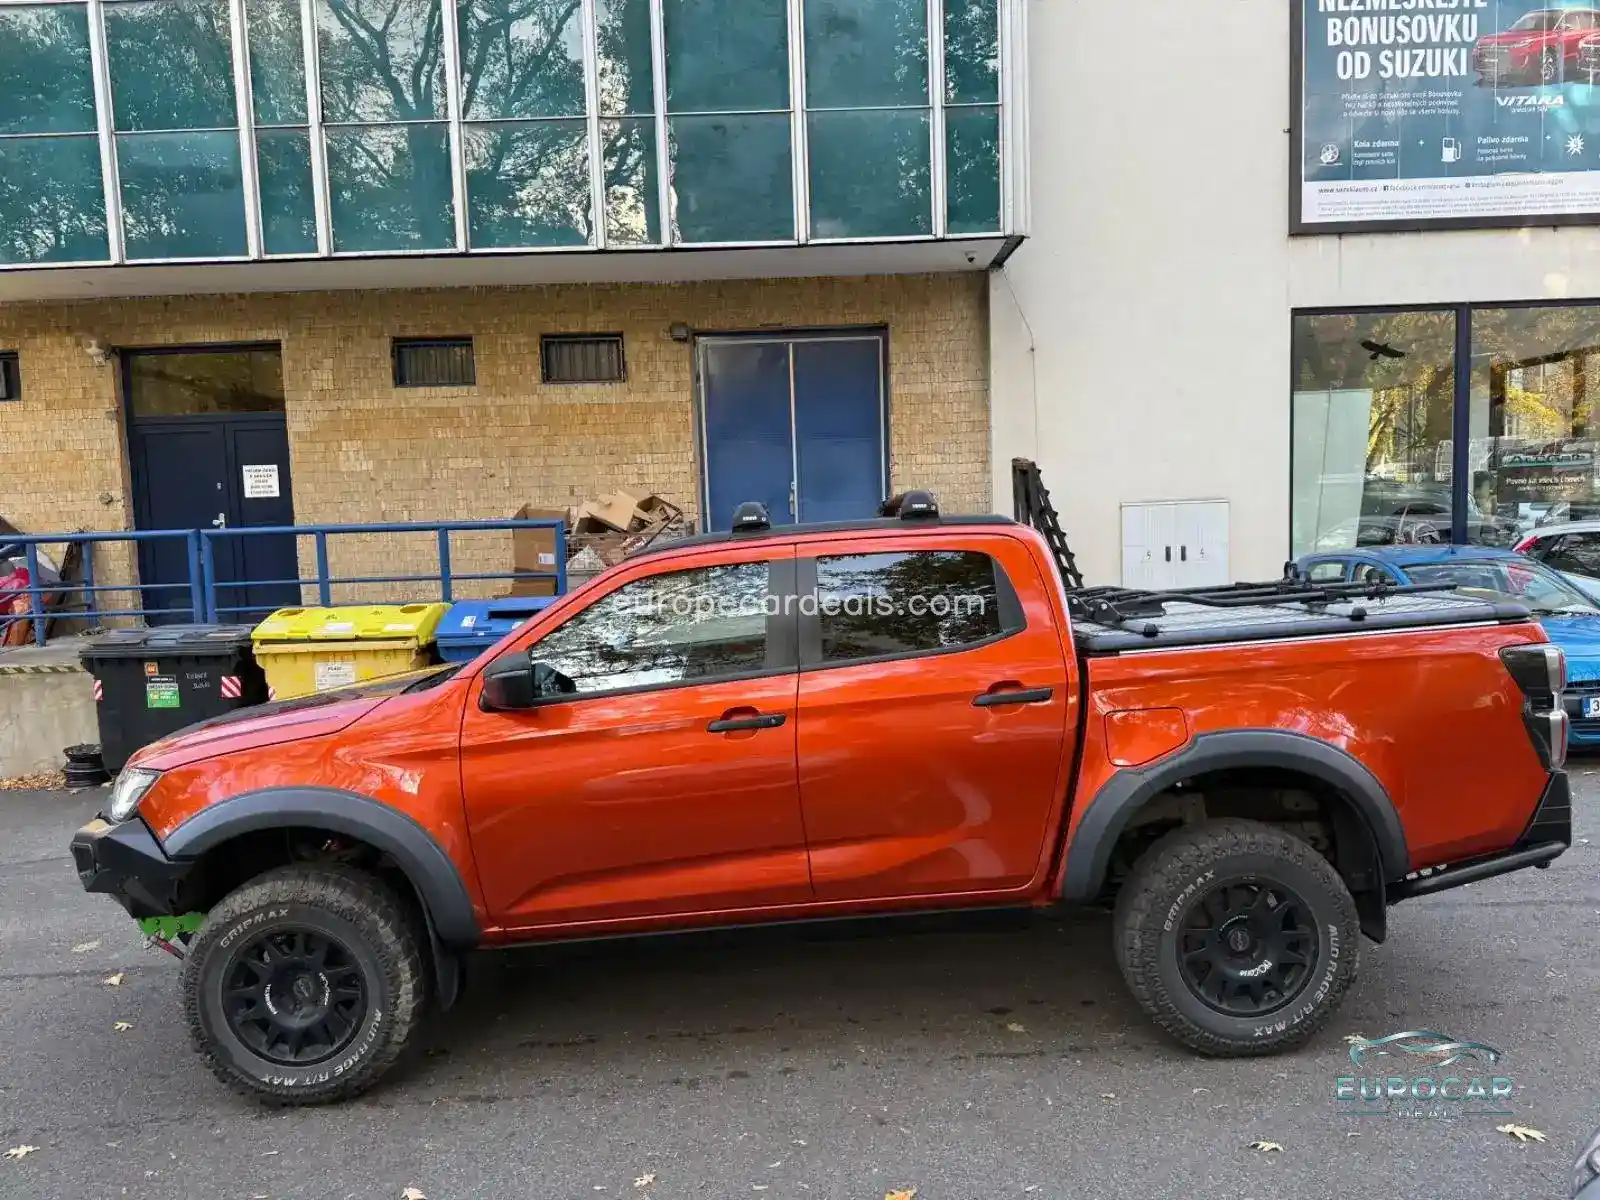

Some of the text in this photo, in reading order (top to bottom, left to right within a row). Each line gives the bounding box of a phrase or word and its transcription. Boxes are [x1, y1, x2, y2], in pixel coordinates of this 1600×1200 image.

[1327, 14, 1478, 46] BONUSOVKU
[1337, 48, 1468, 79] OD SUZUKI
[1496, 95, 1563, 106] VITARA
[220, 908, 289, 948] GRIPMAX
[1253, 1020, 1287, 1037] MAX
[260, 1073, 298, 1086] MAX
